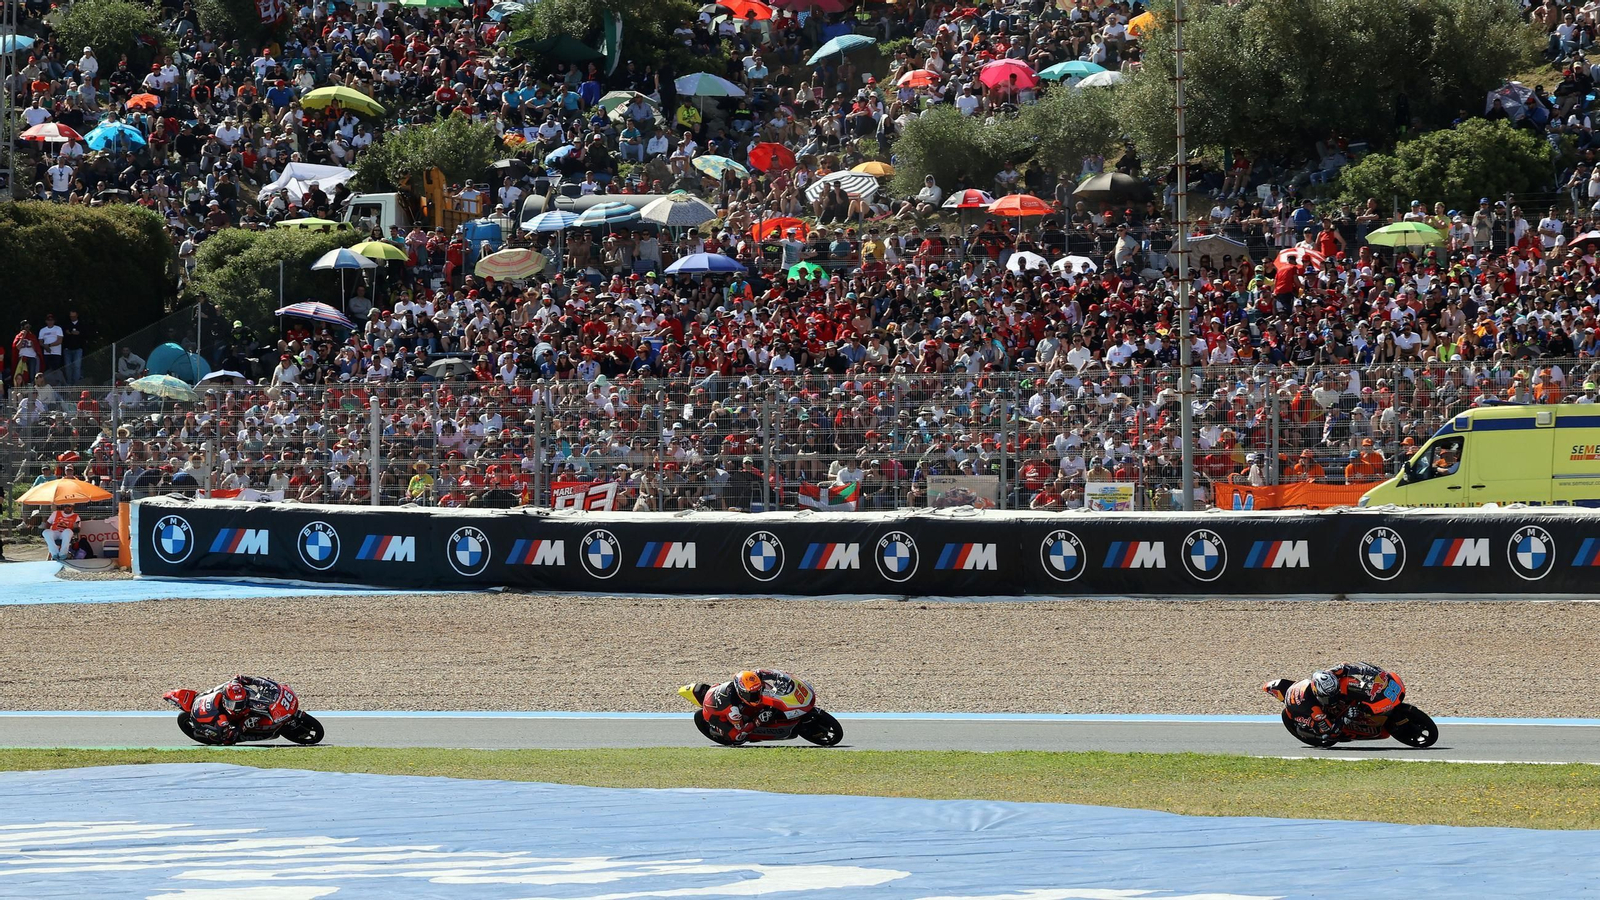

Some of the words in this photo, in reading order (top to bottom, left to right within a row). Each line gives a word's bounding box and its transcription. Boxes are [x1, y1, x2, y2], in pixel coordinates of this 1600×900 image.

[694, 366, 707, 375] 93
[159, 517, 189, 532] BMW
[303, 523, 334, 538] BMW
[453, 529, 485, 543] BMW
[585, 531, 616, 546] BMW
[747, 533, 779, 547] BMW
[880, 533, 911, 548] BMW
[1046, 532, 1079, 547] BMW
[1187, 532, 1221, 546] BMW
[1365, 529, 1399, 545] BMW
[1513, 528, 1550, 543] BMW
[794, 683, 809, 705] 66
[1383, 679, 1401, 703] 99
[281, 690, 294, 711] 36
